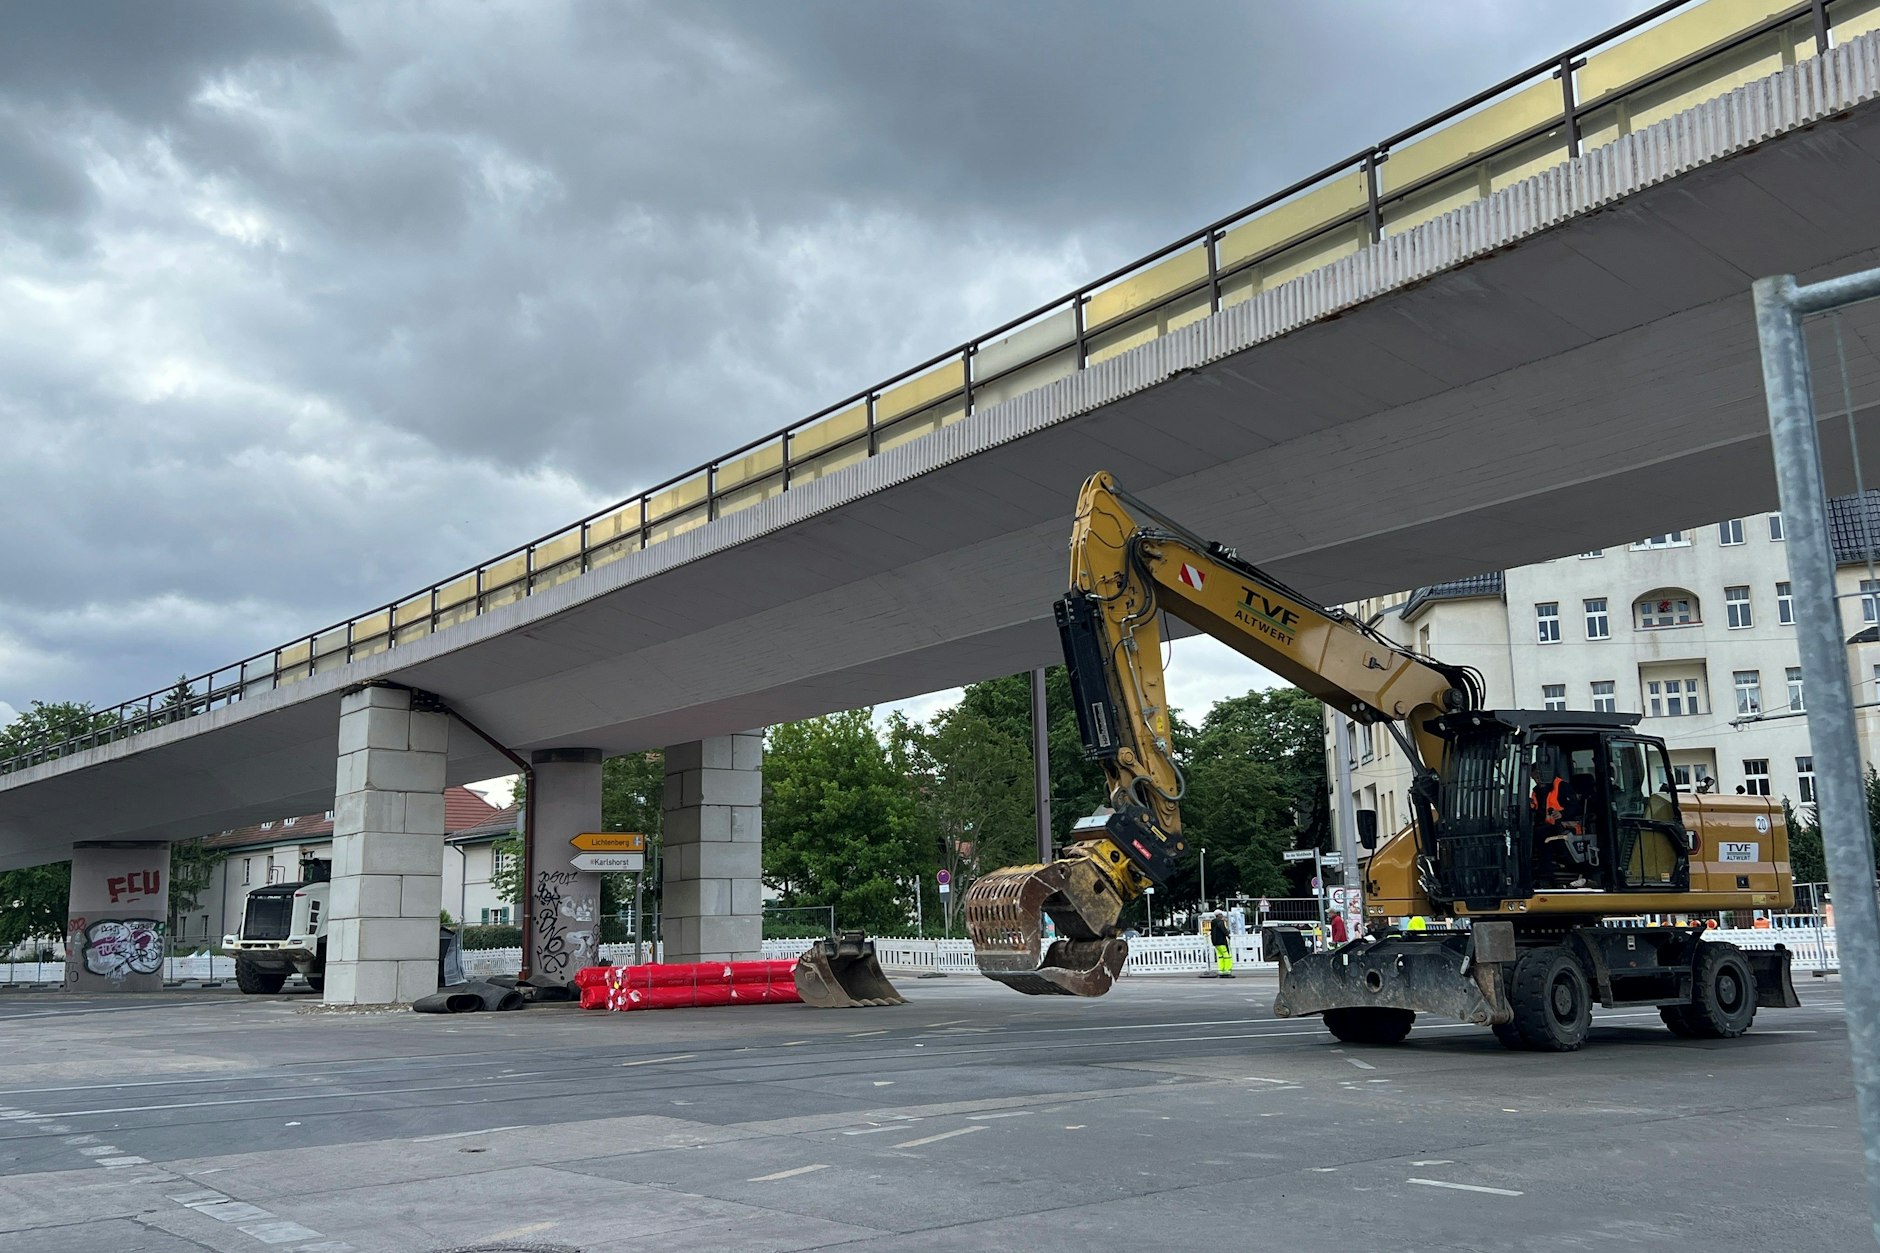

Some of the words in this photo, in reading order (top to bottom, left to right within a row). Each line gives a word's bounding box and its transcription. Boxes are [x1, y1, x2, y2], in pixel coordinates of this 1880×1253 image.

[1241, 585, 1300, 626] TVF
[1234, 610, 1294, 646] ALTWERT
[1756, 818, 1767, 831] 20
[591, 839, 630, 848] Lichtenberg
[1726, 843, 1751, 852] TVF
[594, 858, 629, 866] Karlshorst
[107, 869, 160, 904] FCU
